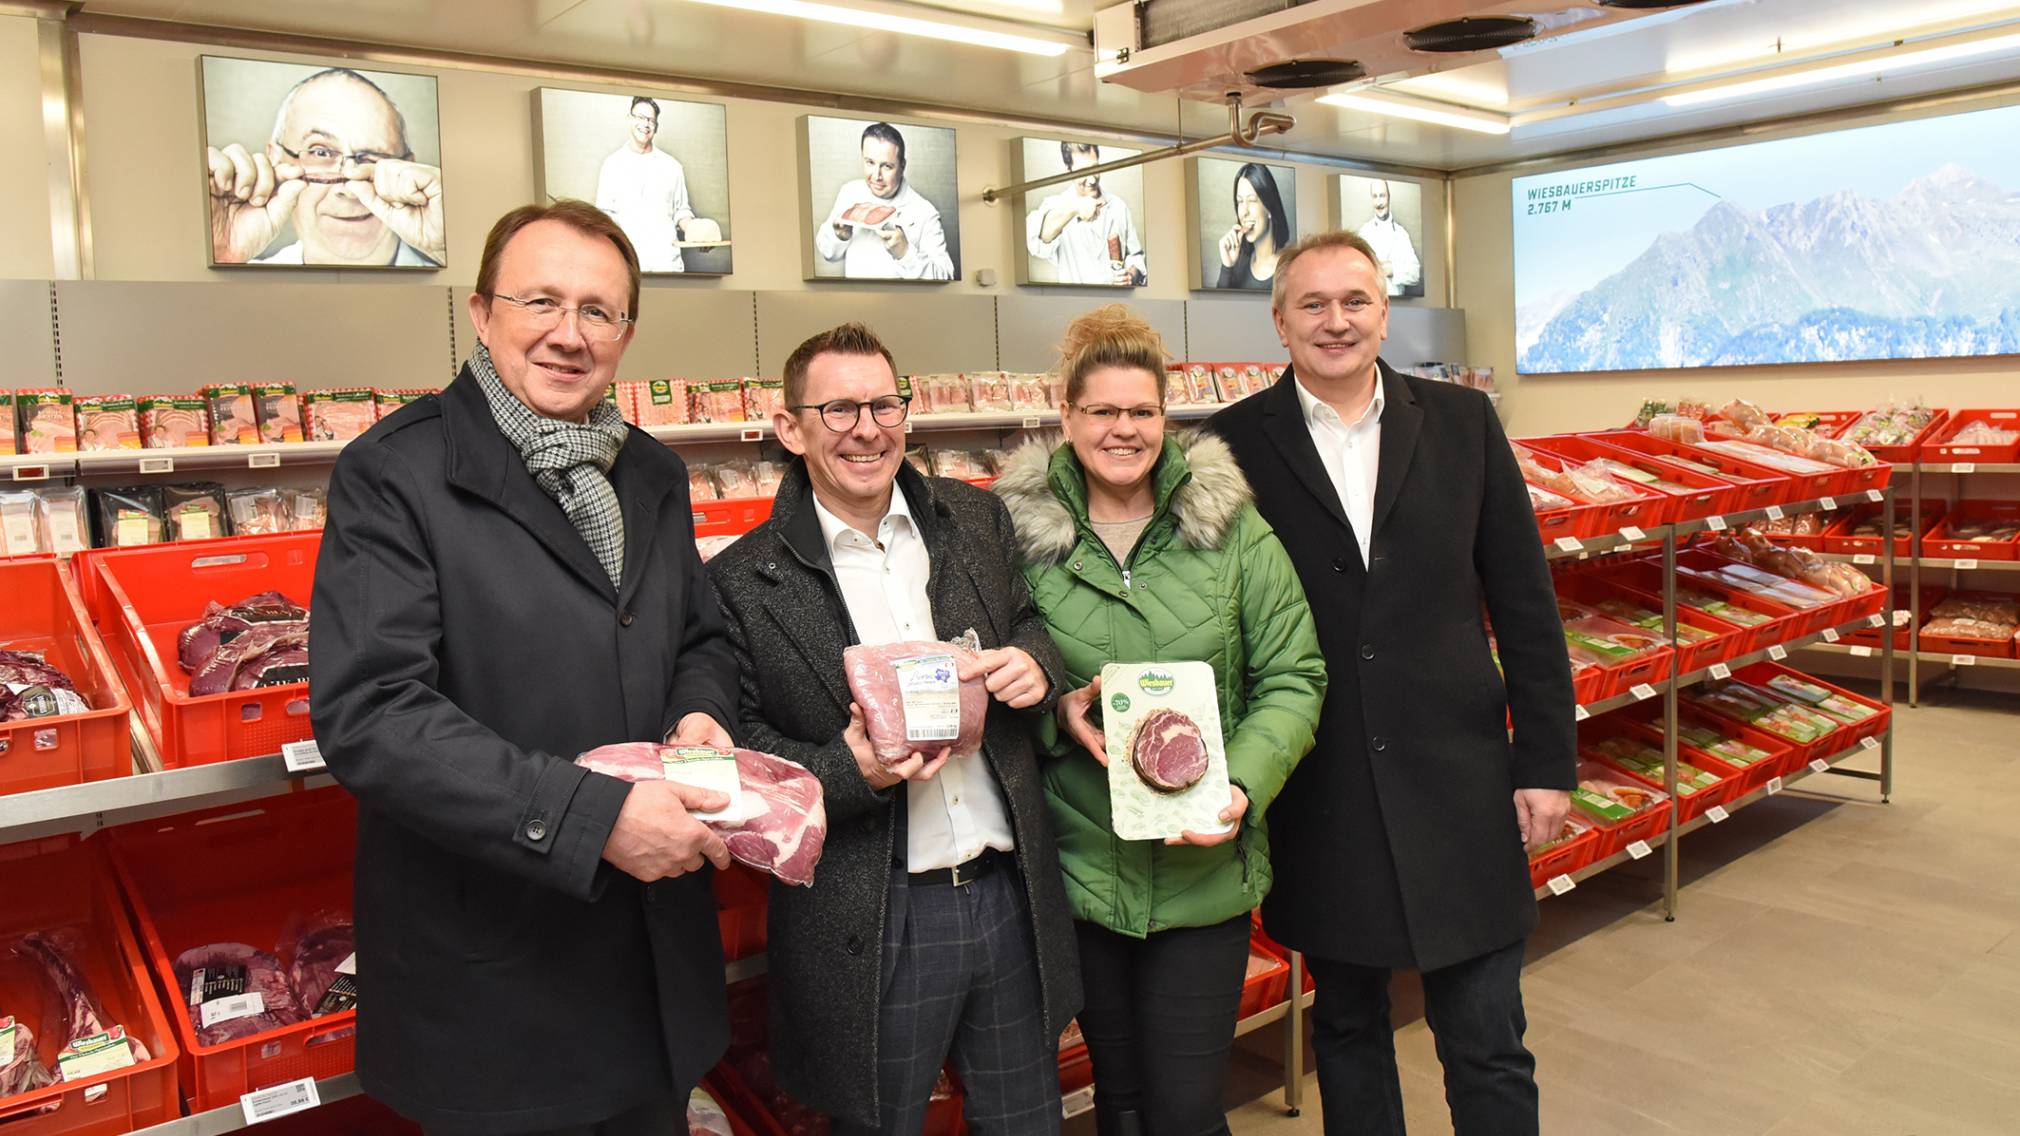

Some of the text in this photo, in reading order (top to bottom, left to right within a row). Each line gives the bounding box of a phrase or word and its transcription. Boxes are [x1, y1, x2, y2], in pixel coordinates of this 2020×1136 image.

[1527, 175, 1637, 200] WIESBAUERSPITZE
[1527, 199, 1572, 215] 2.767 M
